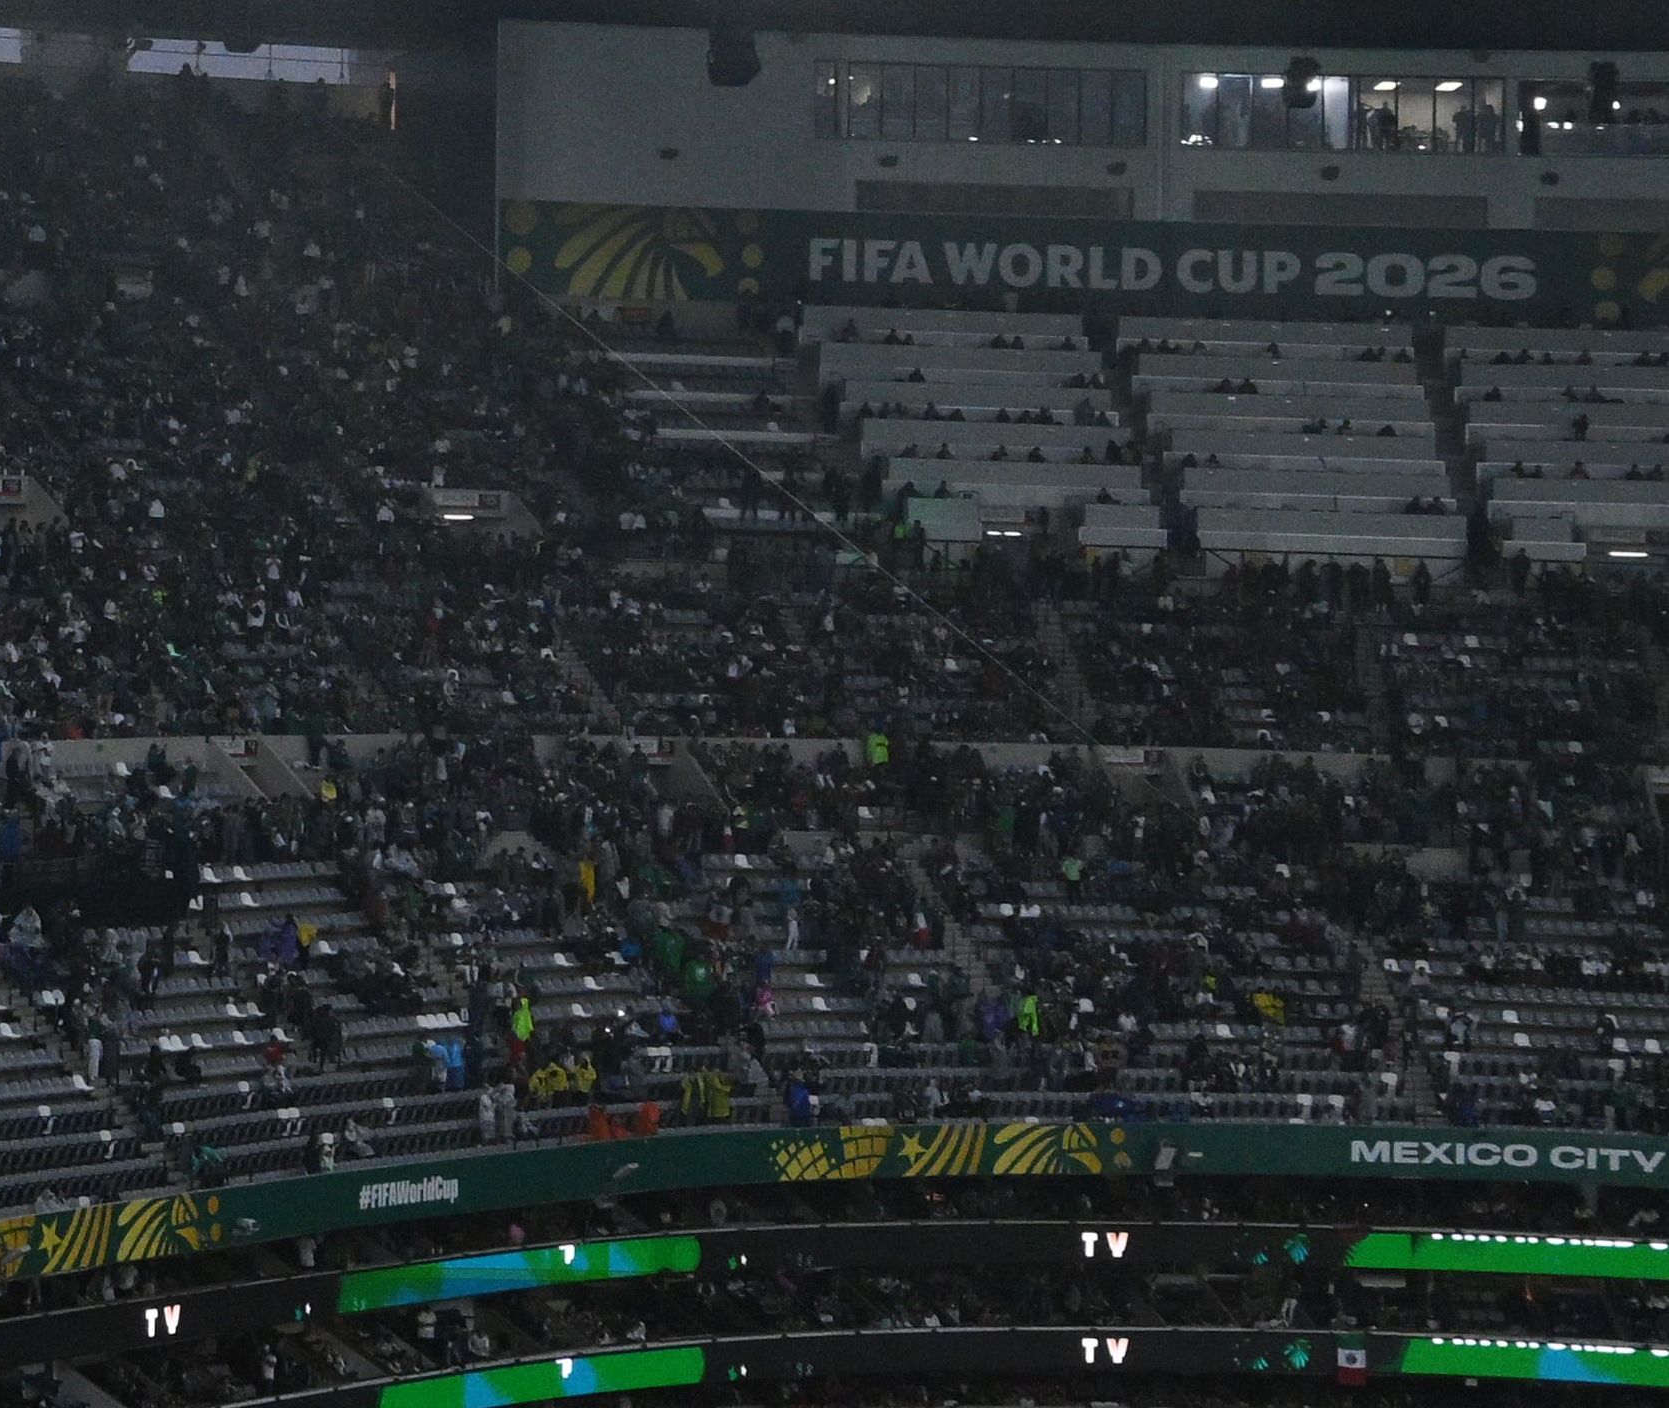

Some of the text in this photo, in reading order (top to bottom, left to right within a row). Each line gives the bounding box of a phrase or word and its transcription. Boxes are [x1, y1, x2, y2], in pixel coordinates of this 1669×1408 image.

[808, 238, 1537, 301] FIFA WORLD CUP 2026
[1350, 1140, 1666, 1173] MEXICO CITY
[359, 1175, 459, 1210] #FIFAWorldCup
